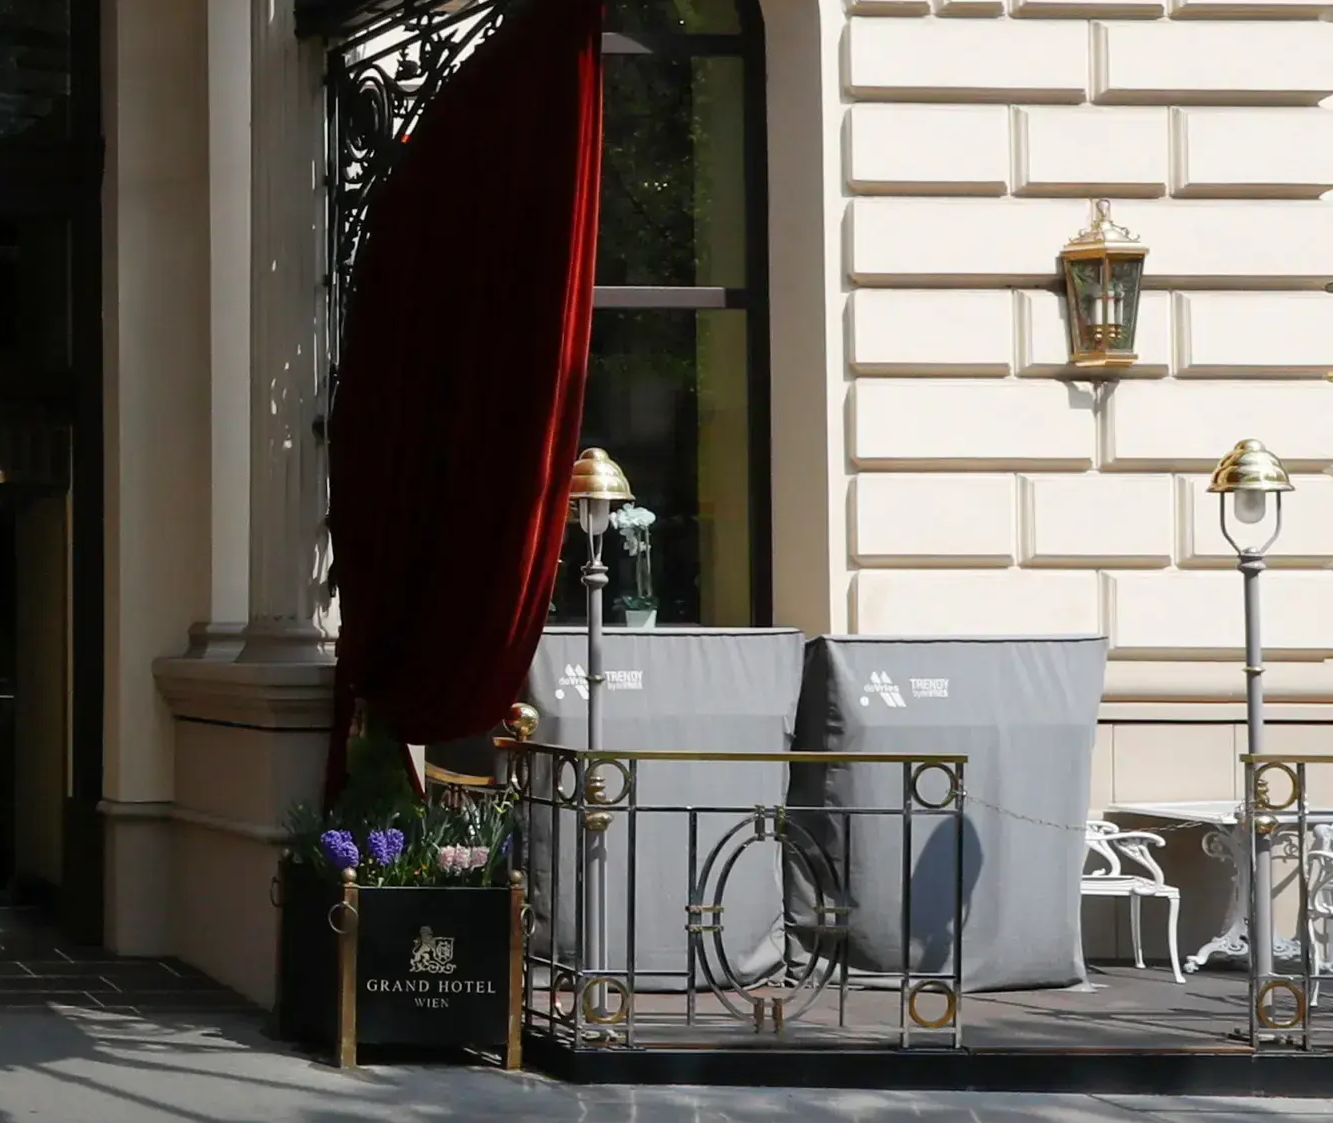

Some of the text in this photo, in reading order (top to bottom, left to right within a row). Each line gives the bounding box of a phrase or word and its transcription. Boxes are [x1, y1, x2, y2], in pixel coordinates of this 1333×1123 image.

[366, 979, 496, 994] GRAND HOTEL
[414, 997, 449, 1008] WIEN
